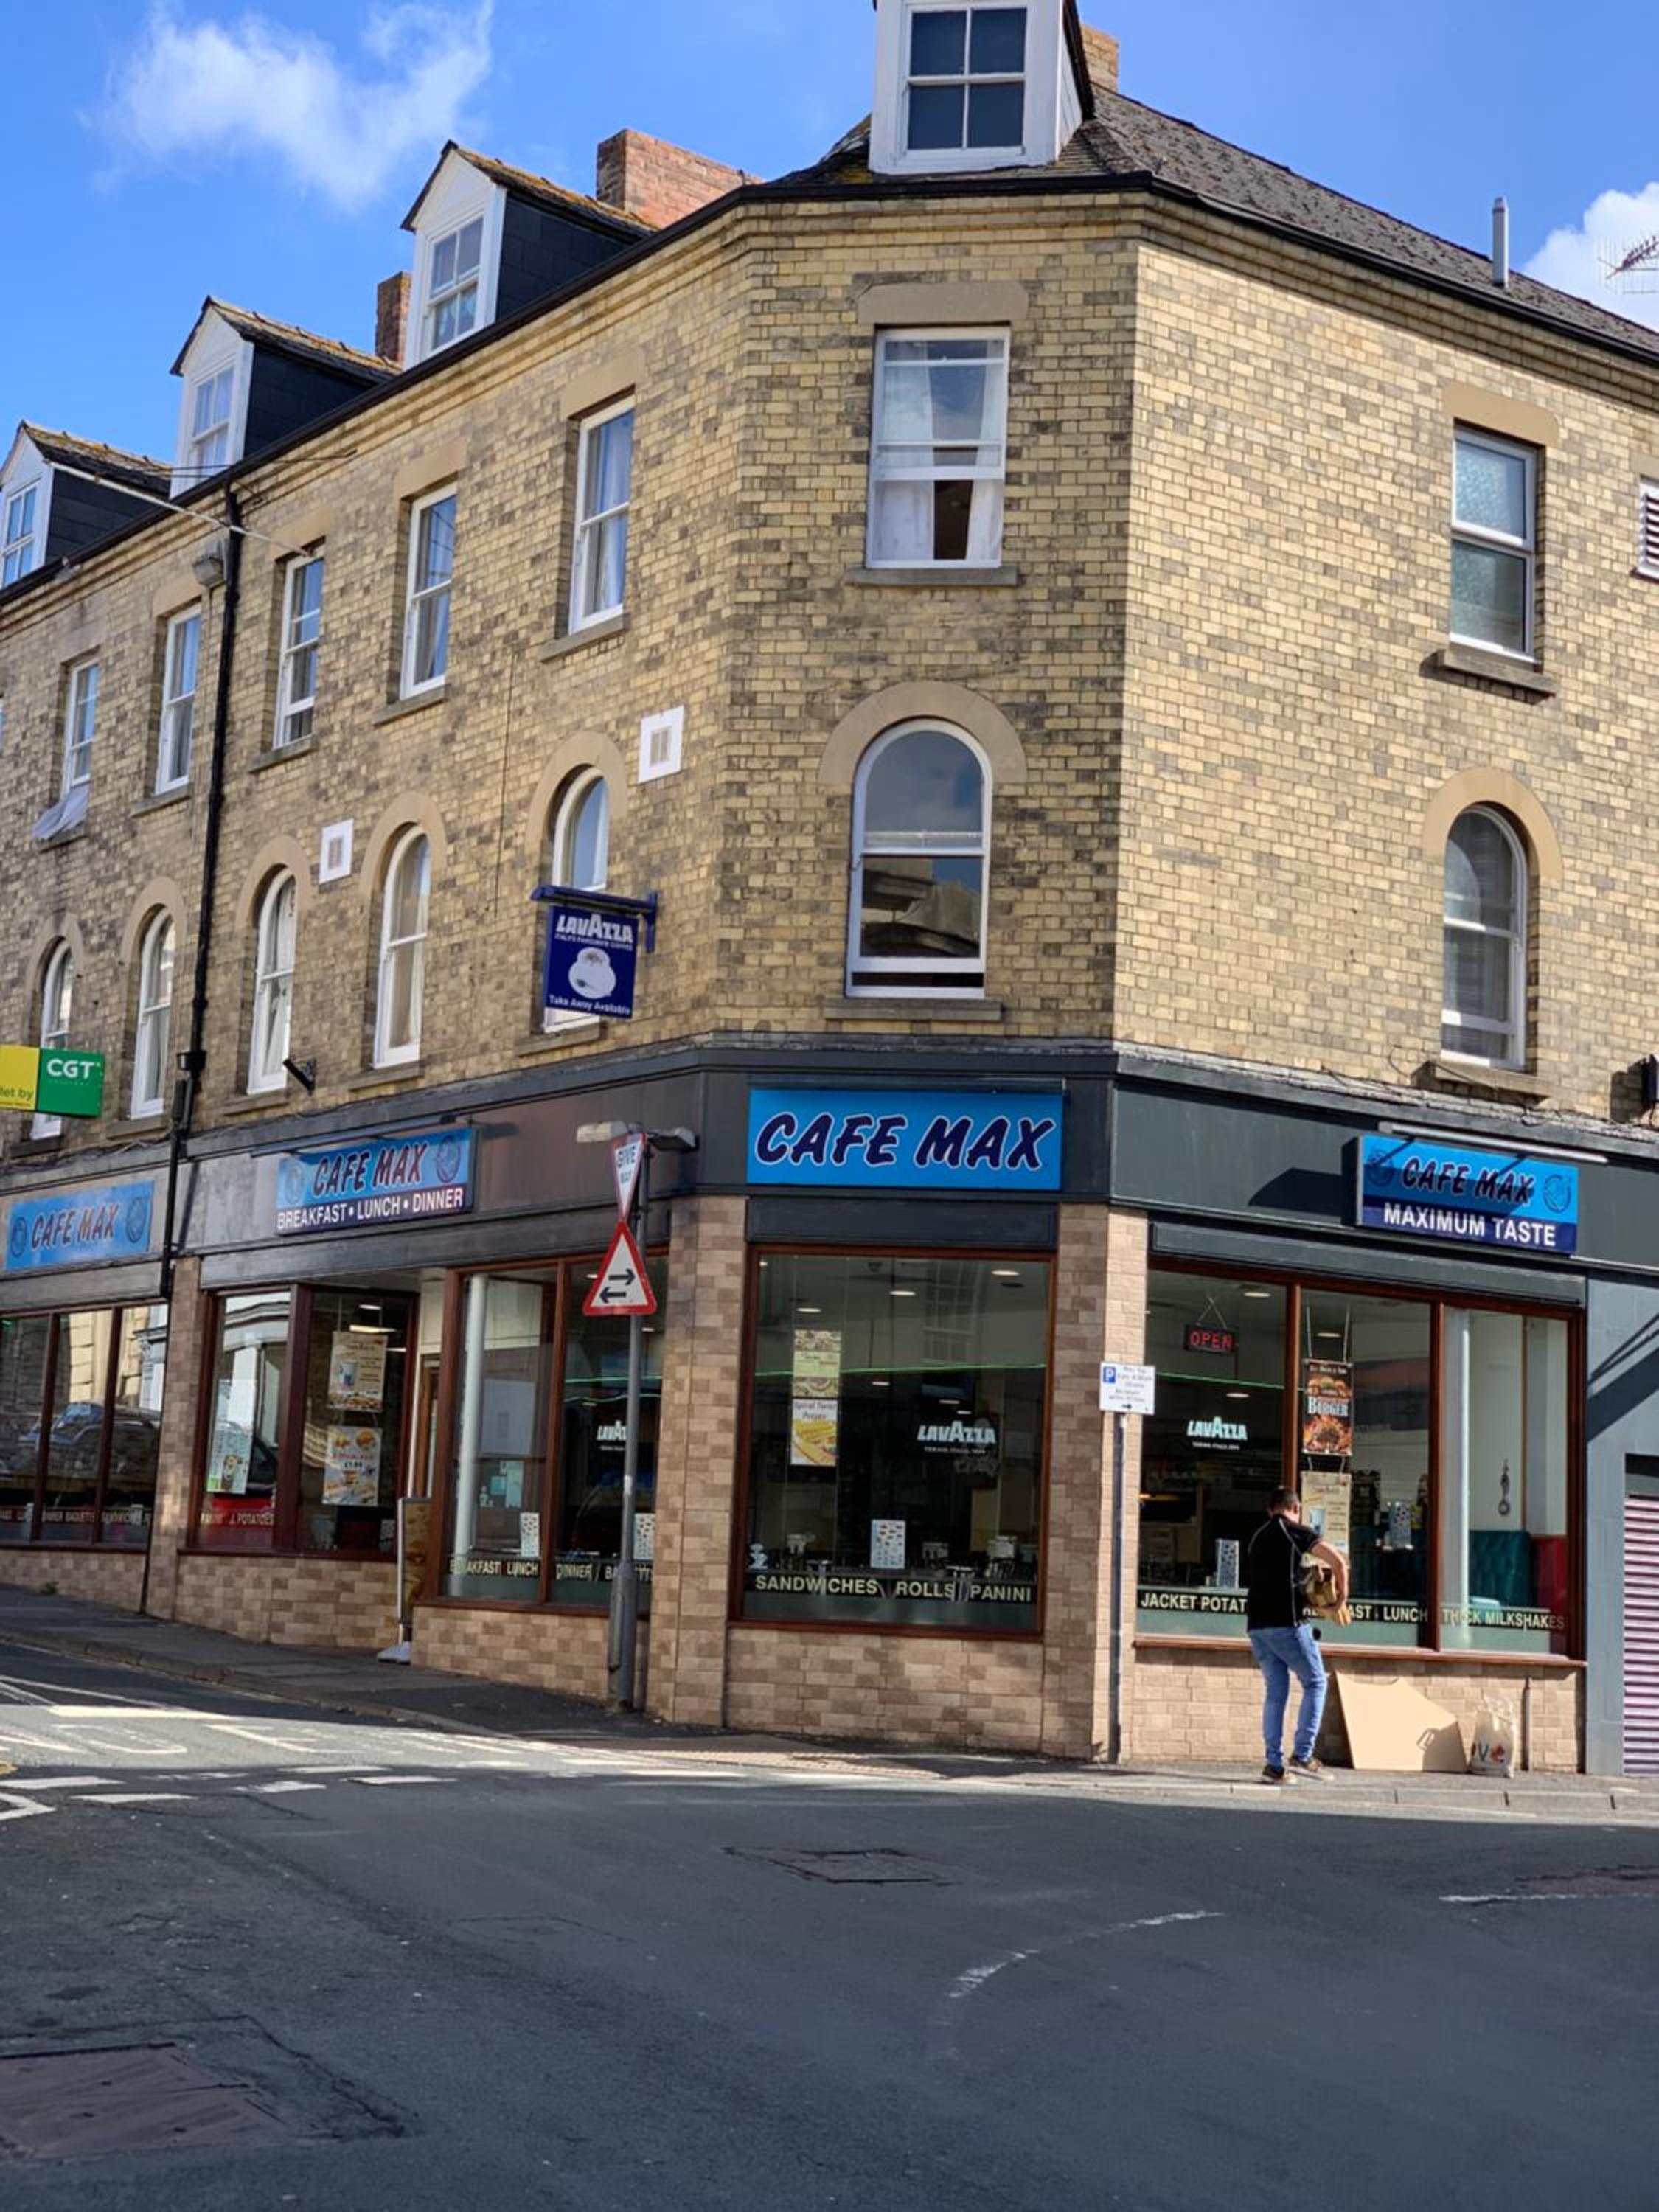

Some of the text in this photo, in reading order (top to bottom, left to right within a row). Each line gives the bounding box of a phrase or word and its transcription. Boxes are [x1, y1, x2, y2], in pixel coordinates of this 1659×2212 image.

[556, 913, 633, 943] LAVAZZA
[549, 995, 568, 1005] Take
[47, 1058, 94, 1079] CGT
[755, 1111, 1056, 1171] CAFE MAX
[313, 1142, 428, 1197] CAFE MAX
[1402, 1155, 1534, 1206] CAFE MAX
[277, 1187, 464, 1230] BREAKFAST LUNCH DINNER
[31, 1203, 119, 1251] CAFE MAX
[1384, 1202, 1557, 1247] MAXIMUM TASTE
[1190, 1331, 1234, 1349] OPEN
[1105, 1368, 1114, 1382] P
[597, 1420, 627, 1441] LAVAZ
[917, 1420, 996, 1444] LAVAZZA
[1186, 1416, 1248, 1441] LAVAZZA
[507, 1561, 538, 1576] LUNCH
[555, 1563, 593, 1580] DINNER
[755, 1575, 1032, 1602] SANDWICHES ROLLS PANINI
[1141, 1593, 1248, 1613] JACKET POTAT
[1383, 1606, 1428, 1621] LUNCH
[1443, 1609, 1565, 1629] THICK MILKSHAKES
